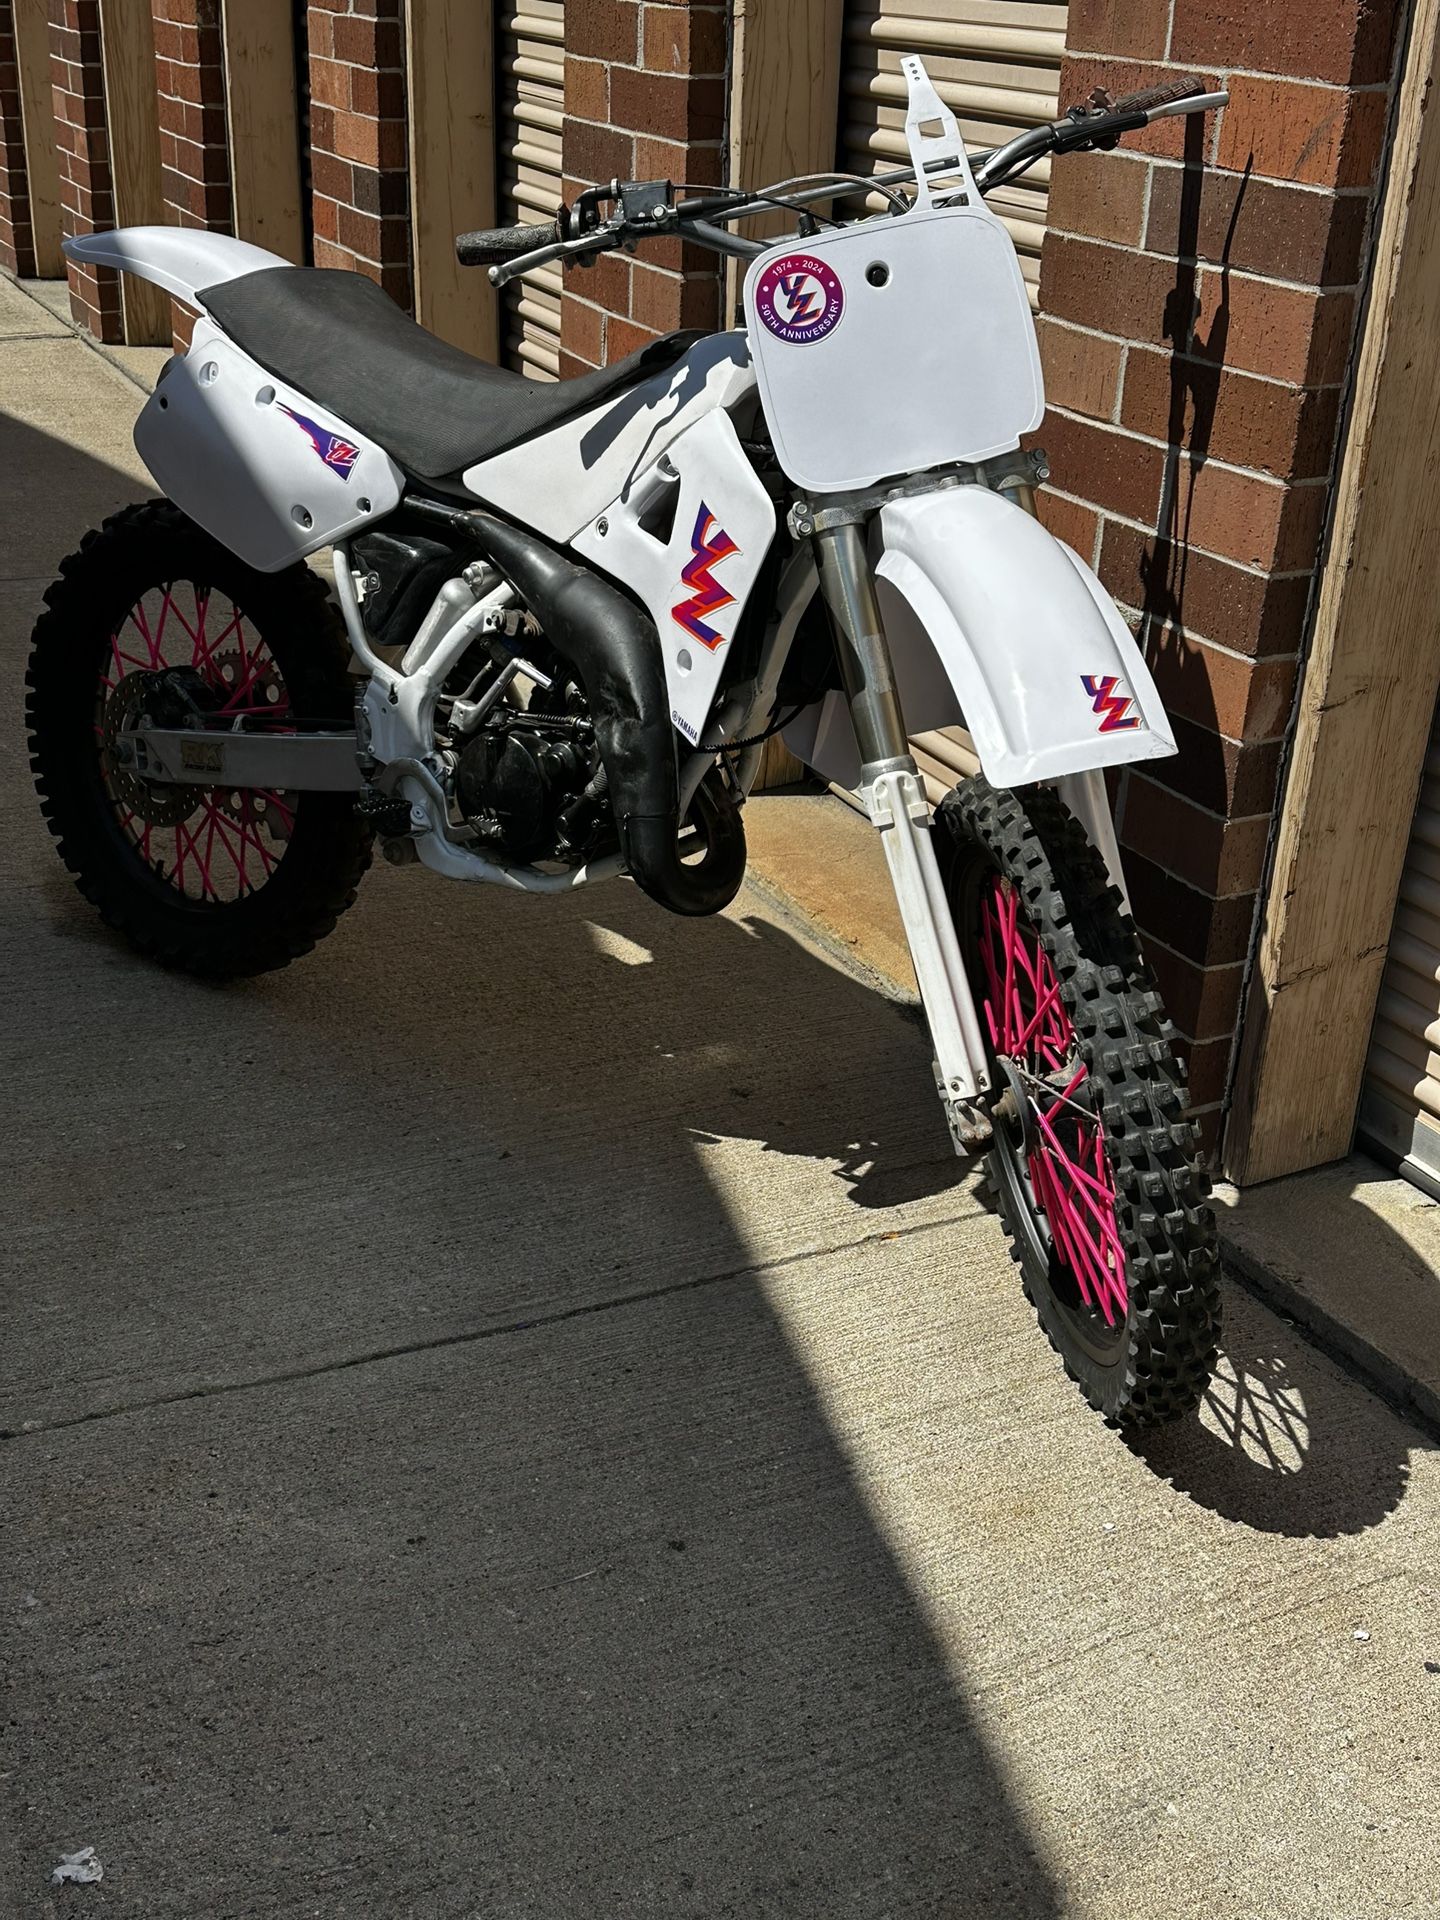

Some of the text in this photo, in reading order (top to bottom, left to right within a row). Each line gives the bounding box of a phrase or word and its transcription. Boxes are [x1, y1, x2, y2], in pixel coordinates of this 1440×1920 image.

[772, 260, 792, 276] 1974
[802, 259, 824, 274] 2024
[761, 298, 839, 339] 50TH ANNIVERSARY
[779, 275, 822, 324] YZ
[1079, 675, 1141, 733] YZ
[677, 716, 698, 742] YAMAHA
